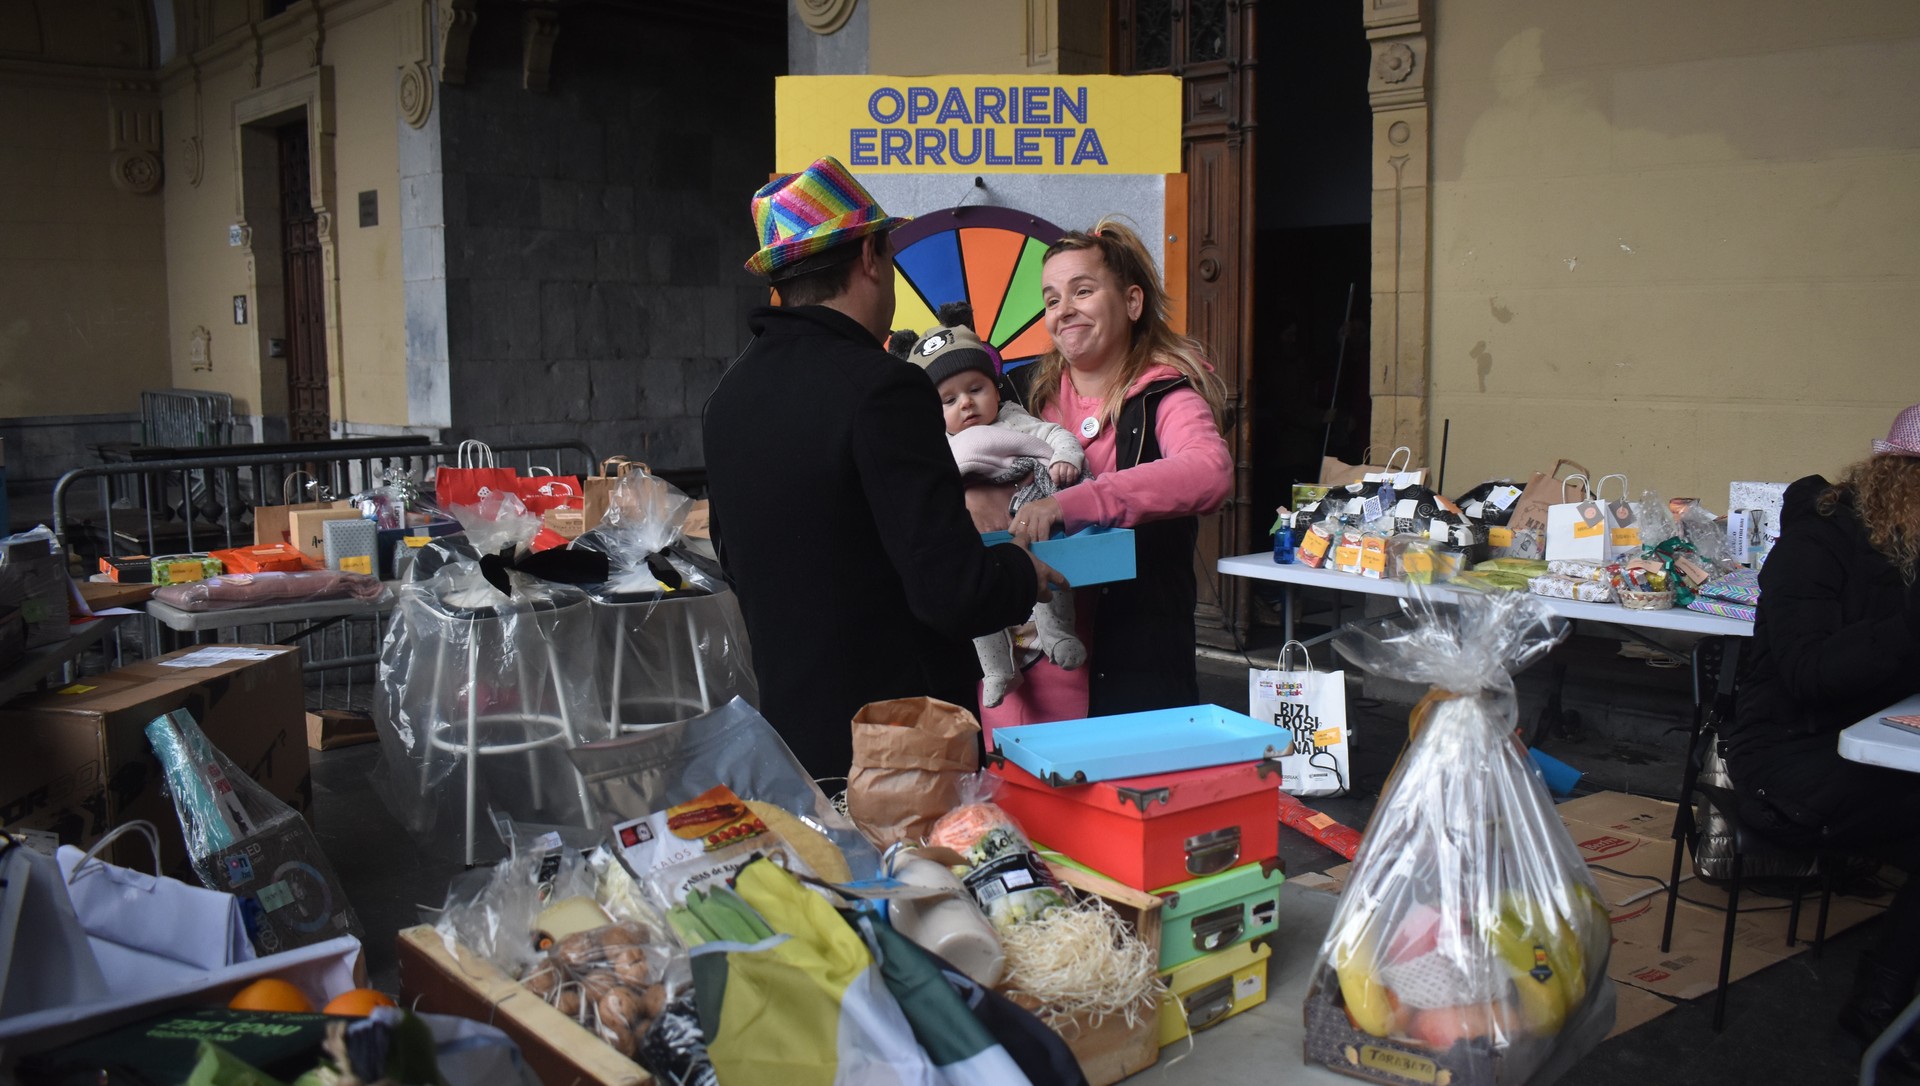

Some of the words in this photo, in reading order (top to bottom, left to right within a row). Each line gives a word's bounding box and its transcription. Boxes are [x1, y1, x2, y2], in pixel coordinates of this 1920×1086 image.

[868, 86, 1088, 124] OPARIEN
[850, 128, 1108, 166] ERRULETA
[1274, 713, 1319, 730] EROSI
[1280, 702, 1309, 716] BIZI
